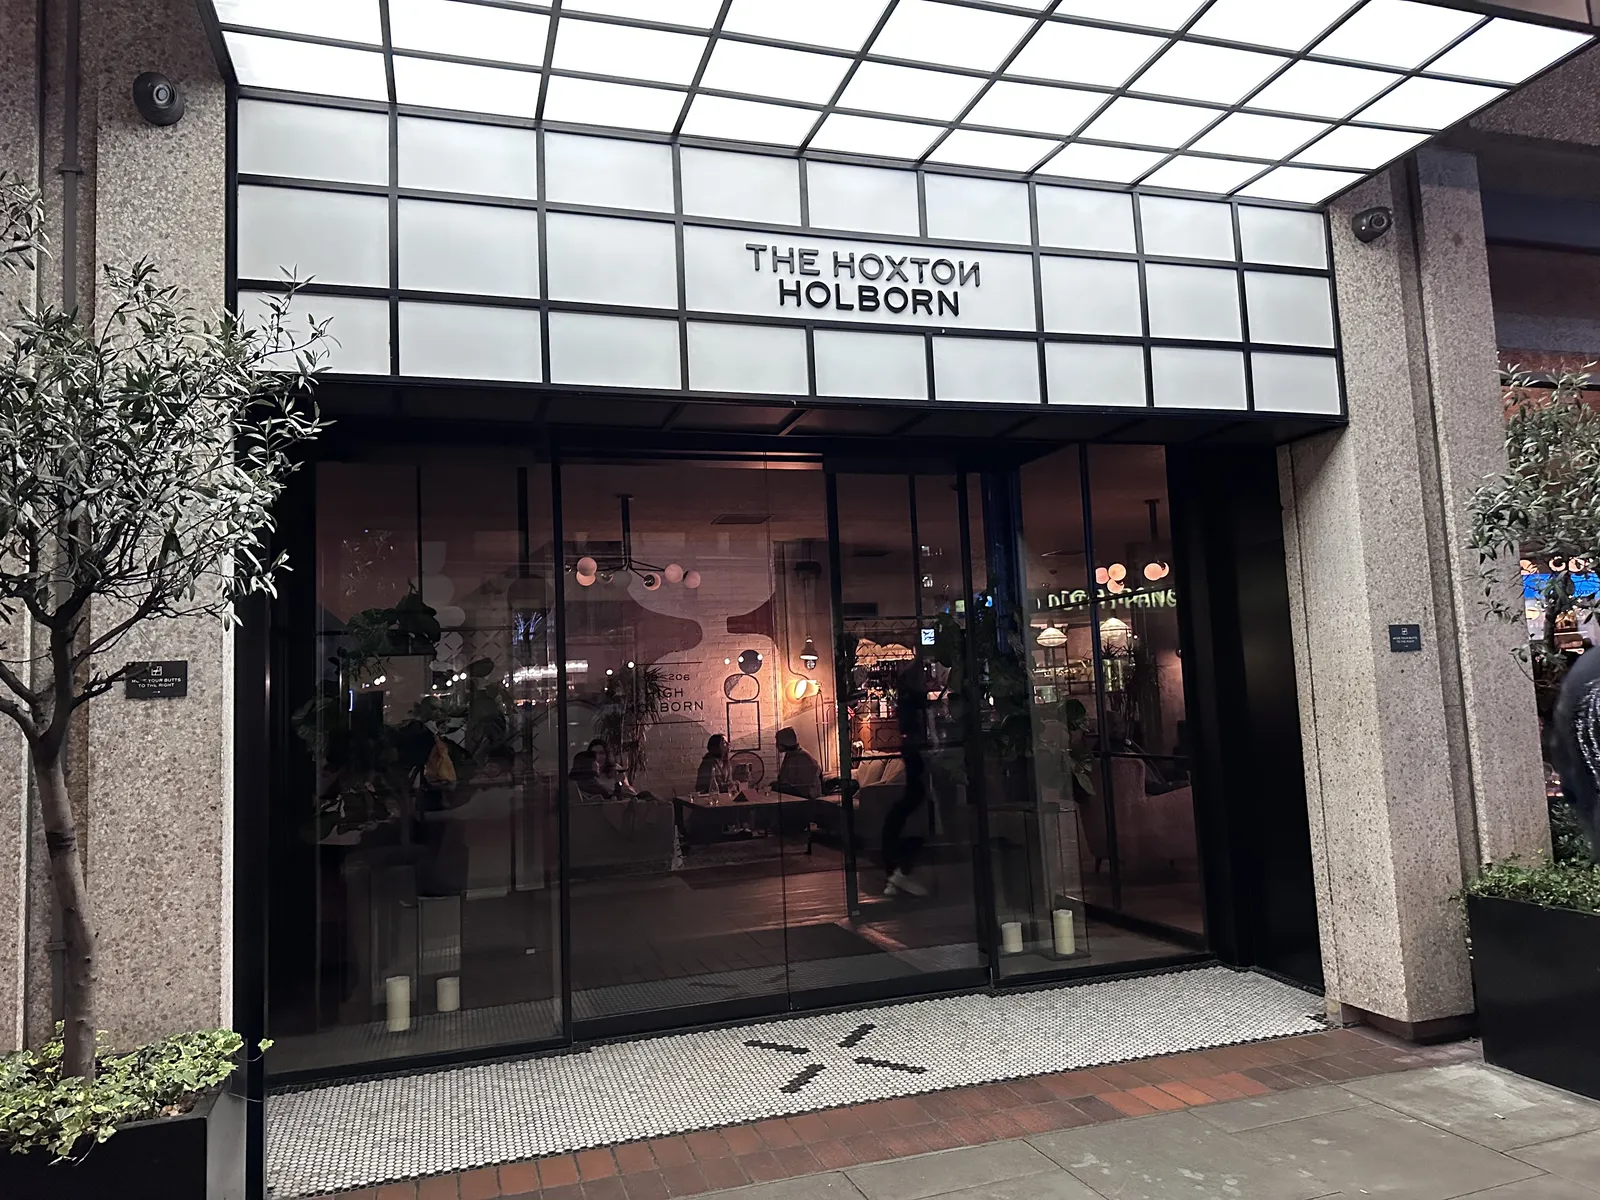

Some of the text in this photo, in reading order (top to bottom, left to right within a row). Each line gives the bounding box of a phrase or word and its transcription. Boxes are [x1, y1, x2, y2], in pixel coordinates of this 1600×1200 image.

[745, 243, 981, 288] THE HOXTON
[778, 278, 960, 317] HOLBORN
